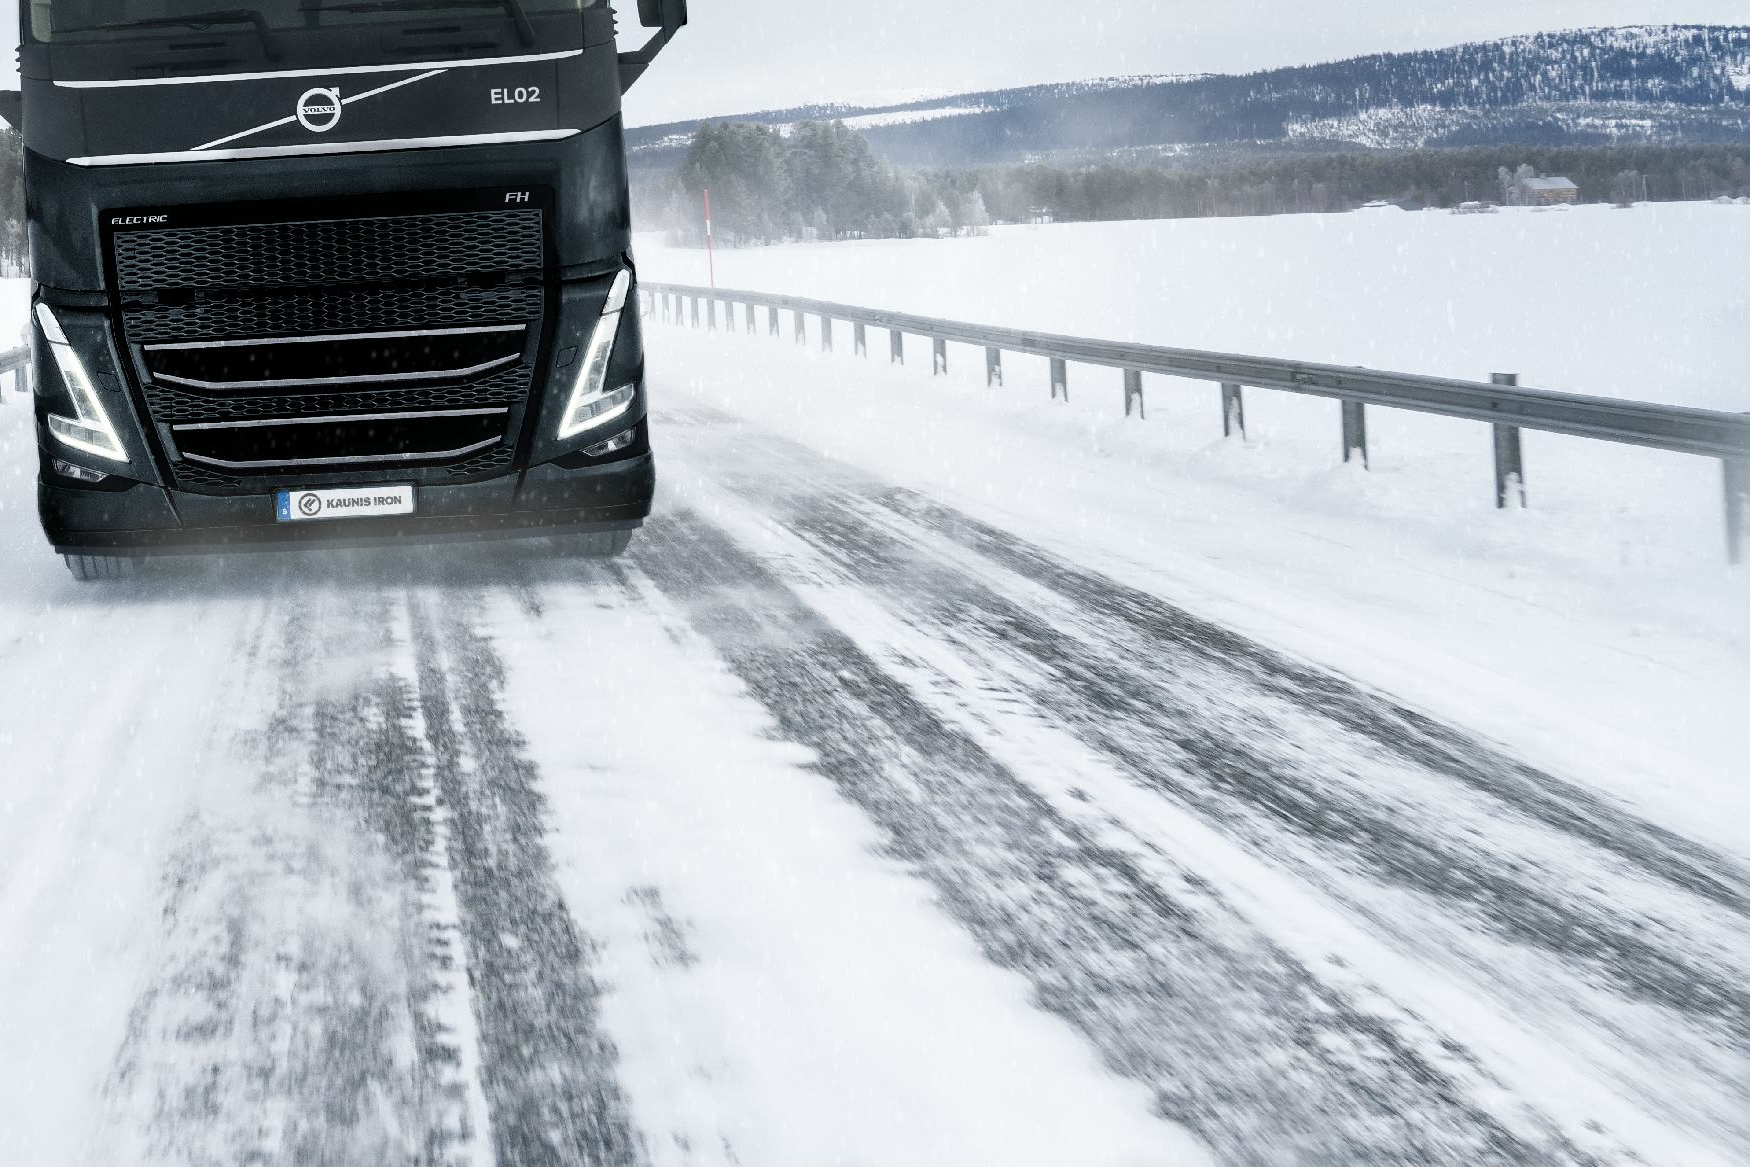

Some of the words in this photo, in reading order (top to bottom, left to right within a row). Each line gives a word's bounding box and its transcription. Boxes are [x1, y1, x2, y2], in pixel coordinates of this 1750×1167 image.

[490, 86, 541, 104] EL02
[302, 106, 336, 114] VOLVO
[505, 191, 530, 203] FH
[111, 215, 168, 225] ELECTRIC
[326, 497, 371, 509] KAUNIS
[373, 495, 402, 506] IRON
